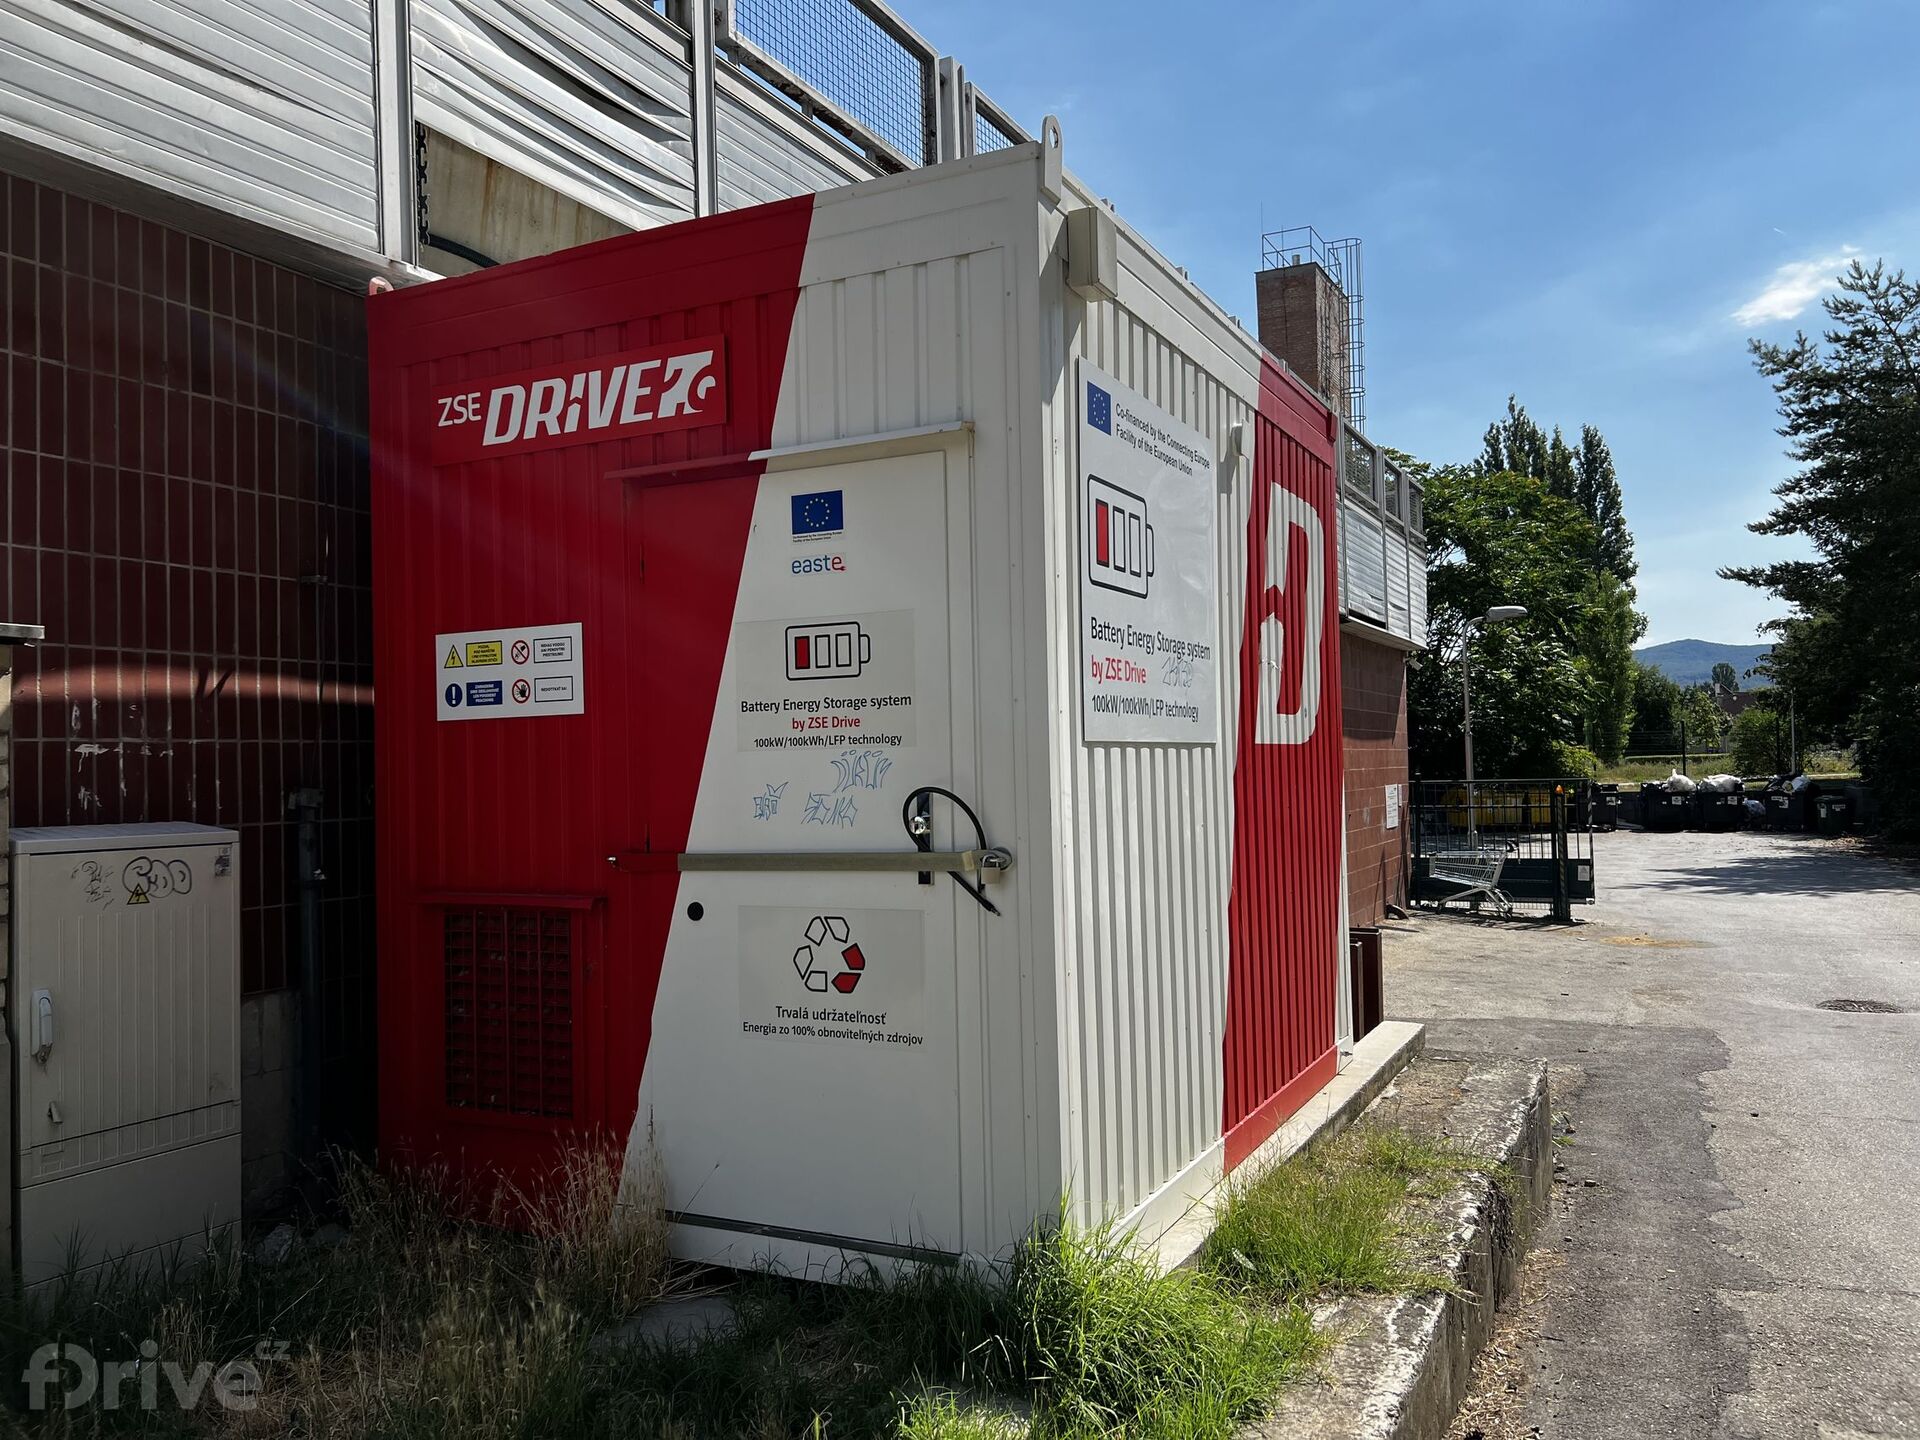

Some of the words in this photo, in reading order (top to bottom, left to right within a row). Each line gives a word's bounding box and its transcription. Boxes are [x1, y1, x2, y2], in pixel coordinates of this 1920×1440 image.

[437, 392, 481, 427] ZSE
[1115, 403, 1149, 434] Co-financed
[1150, 422, 1157, 441] by
[1157, 429, 1166, 444] the
[1166, 434, 1194, 463] Connecting
[1194, 450, 1210, 470] Europe
[1116, 423, 1136, 449] Facility
[1144, 442, 1153, 456] the
[1154, 445, 1178, 469] European
[1178, 460, 1193, 477] Union
[1091, 616, 1125, 650] Battery
[1127, 624, 1155, 655] Energy
[1157, 631, 1186, 660] Storage
[1187, 642, 1211, 662] system
[1091, 654, 1103, 684] by
[1105, 657, 1122, 681] ZSE
[1125, 660, 1147, 684] Drive
[741, 700, 780, 714] Battery
[783, 699, 821, 713] Energy
[824, 696, 868, 710] Storage
[870, 695, 912, 709] system
[1092, 694, 1164, 718] 100kW/100kWh/LFP
[1165, 700, 1199, 723] technology
[792, 717, 805, 732] by
[808, 716, 828, 729] ZSE
[832, 716, 861, 728] Drive
[754, 735, 846, 748] 100kW/100kWh/LFP
[849, 733, 902, 747] technology
[776, 1005, 809, 1020] Trvalá
[812, 1008, 888, 1025] udržateľnosť
[743, 1021, 777, 1036] Energia
[779, 1026, 790, 1035] zo
[791, 1025, 816, 1037] 100%
[817, 1027, 884, 1043] obnoviteľných
[886, 1033, 923, 1047] zdrojov
